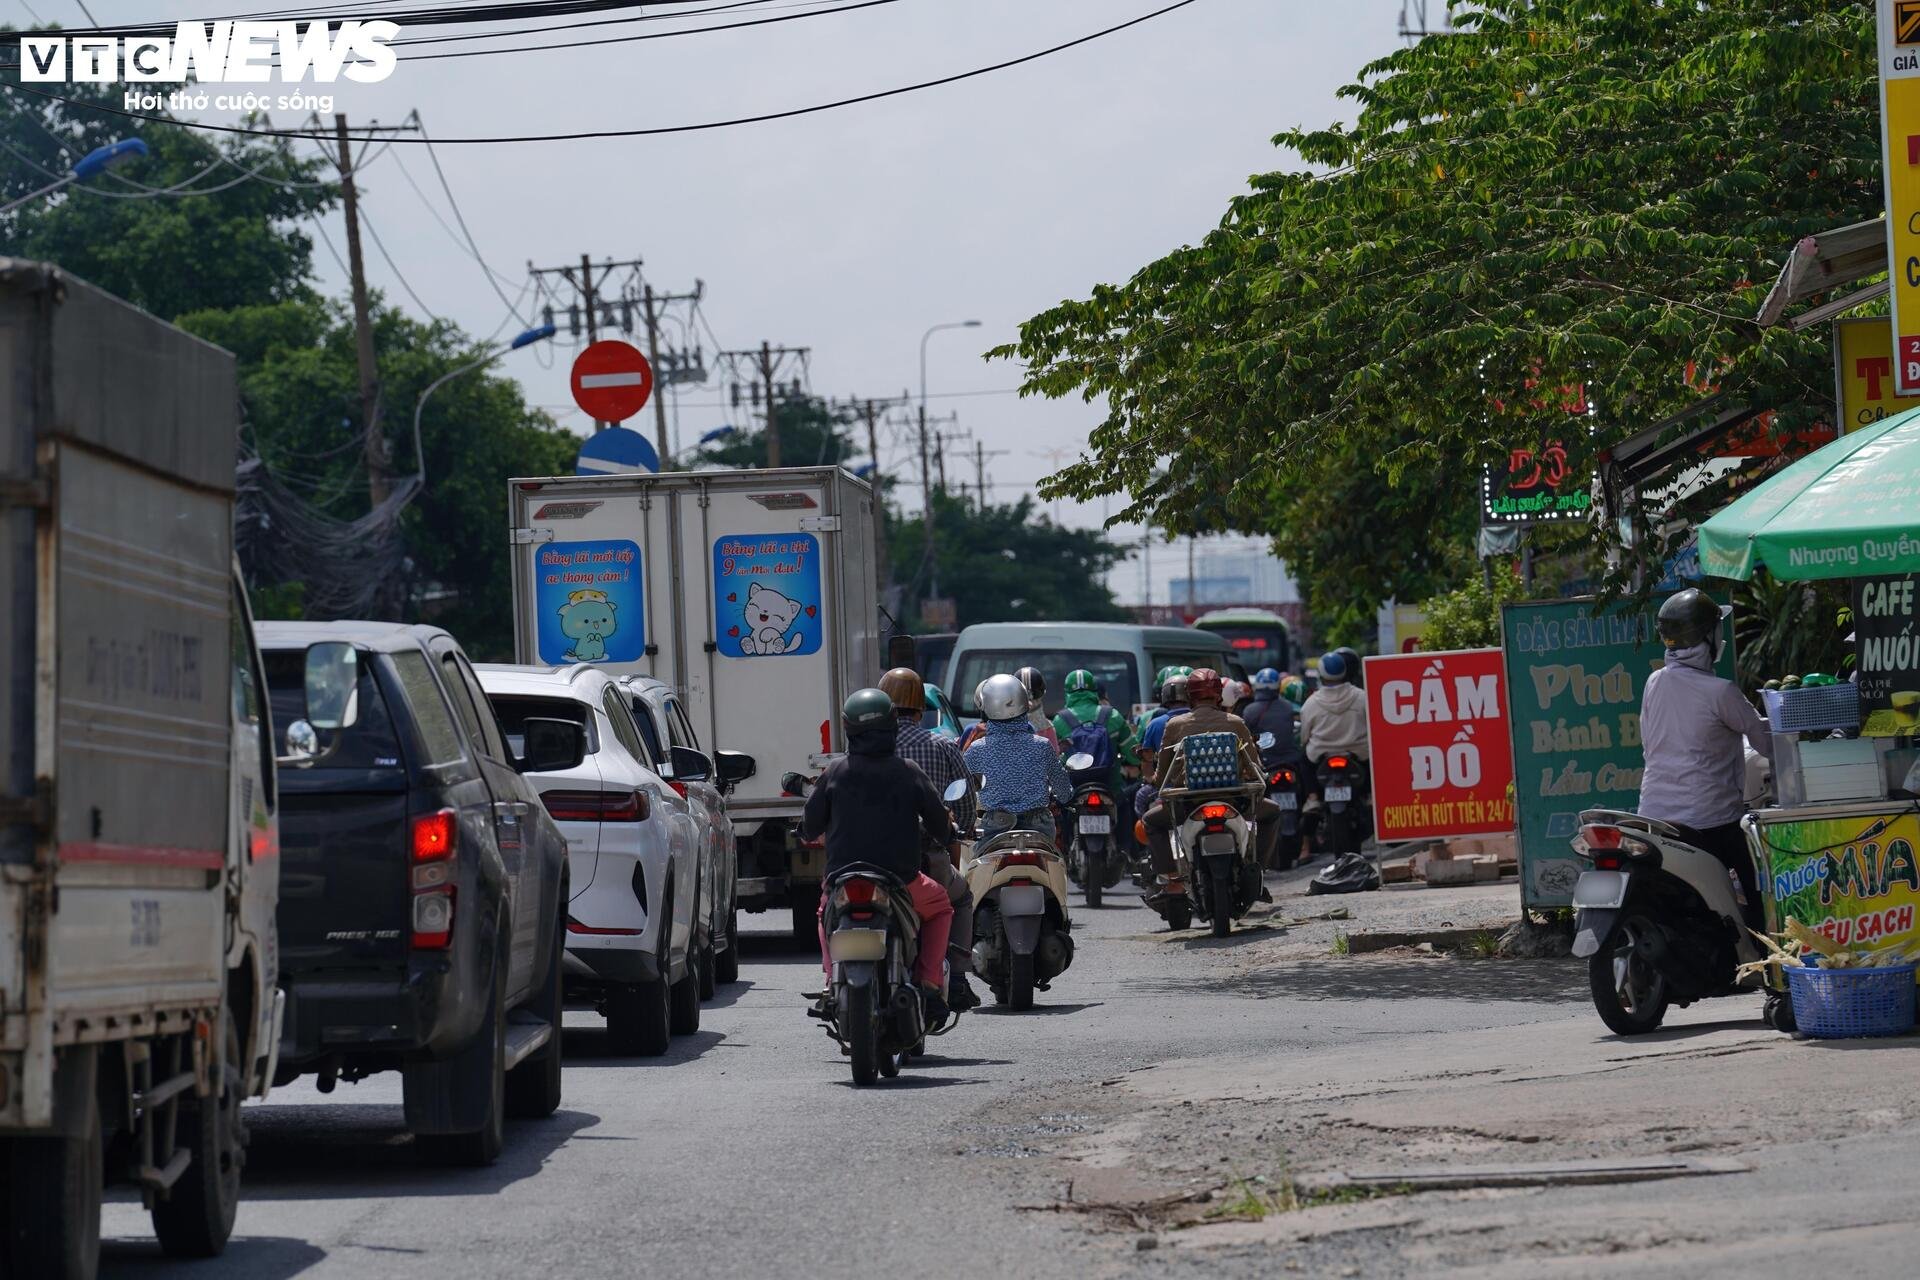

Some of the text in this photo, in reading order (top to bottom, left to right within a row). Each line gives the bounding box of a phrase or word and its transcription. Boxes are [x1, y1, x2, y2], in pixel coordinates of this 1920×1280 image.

[723, 558, 735, 576] 9
[1789, 545, 1858, 567] Nhượng
[1517, 615, 1561, 656] ĐẶC
[1564, 607, 1606, 649] SẢN
[1863, 621, 1920, 672] MUỐI
[1381, 660, 1500, 725] CẦM
[1529, 662, 1634, 710] Phú
[1530, 713, 1642, 754] Bánh Đ
[1409, 724, 1482, 790] ĐỒ
[1540, 759, 1592, 796] Lẩu
[1384, 793, 1429, 828] CHUYỂN
[1433, 797, 1455, 825] RÚT
[1457, 791, 1485, 823] TIỀN
[1820, 818, 1920, 905] MÍA
[1856, 904, 1916, 944] SẠCH
